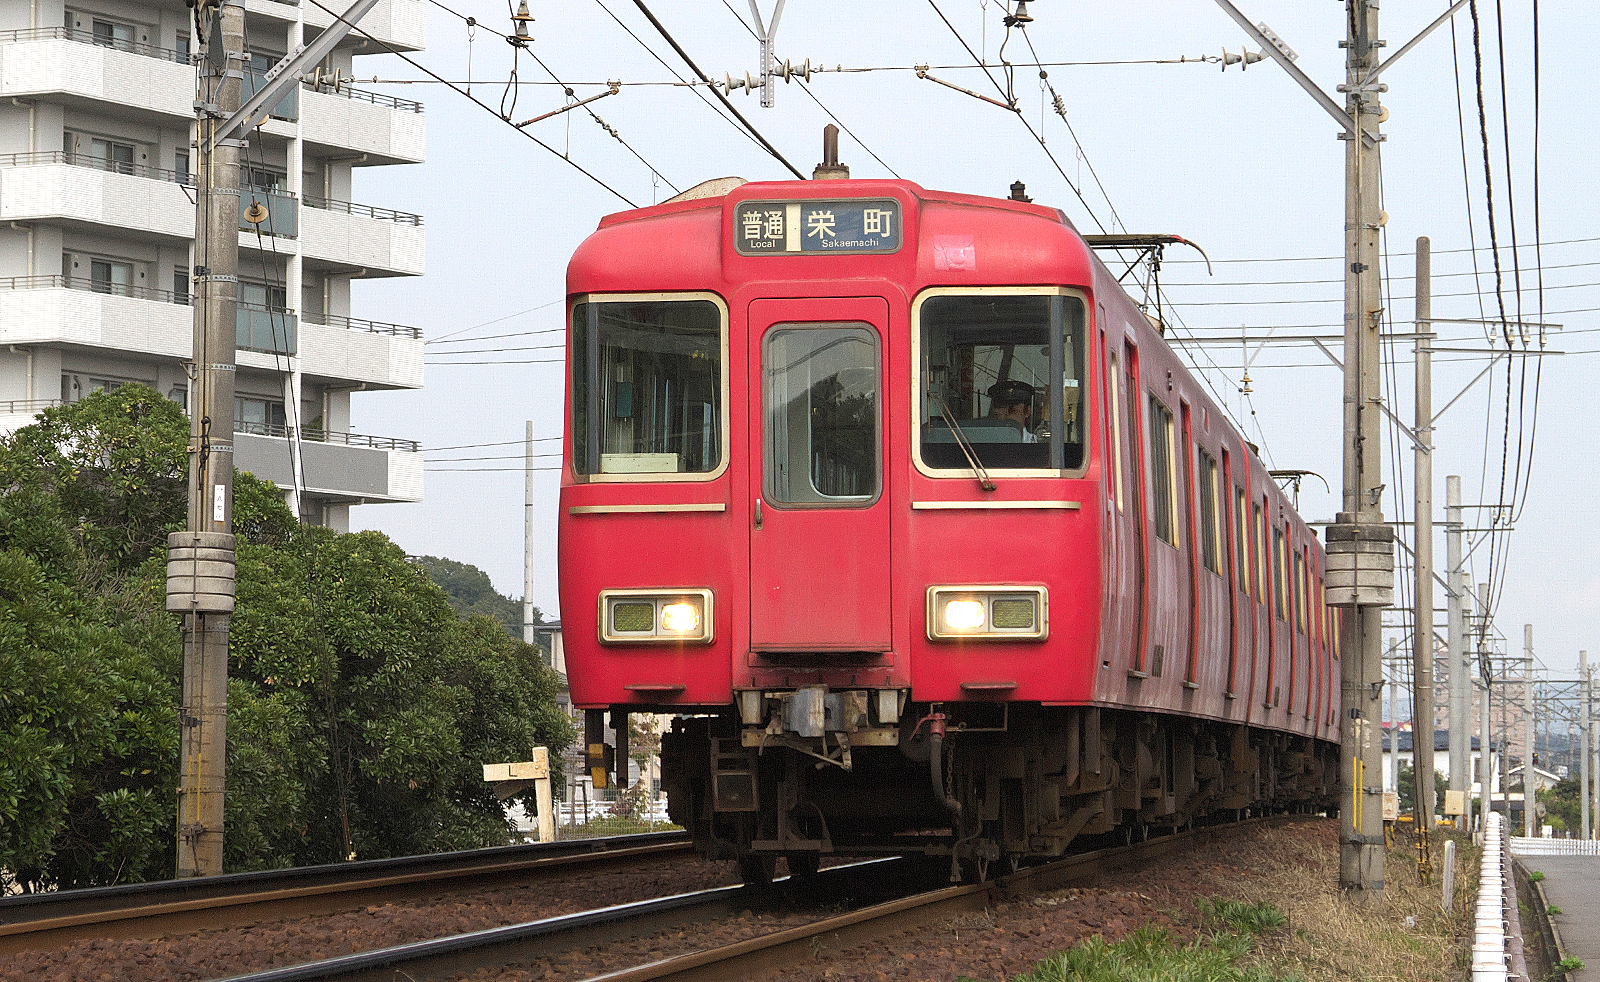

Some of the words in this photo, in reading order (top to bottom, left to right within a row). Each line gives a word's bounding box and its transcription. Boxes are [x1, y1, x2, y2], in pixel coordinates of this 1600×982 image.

[743, 210, 784, 240] 普通
[807, 208, 893, 240] 栄町
[750, 239, 776, 248] Local
[821, 238, 879, 248] Sakaemachi
